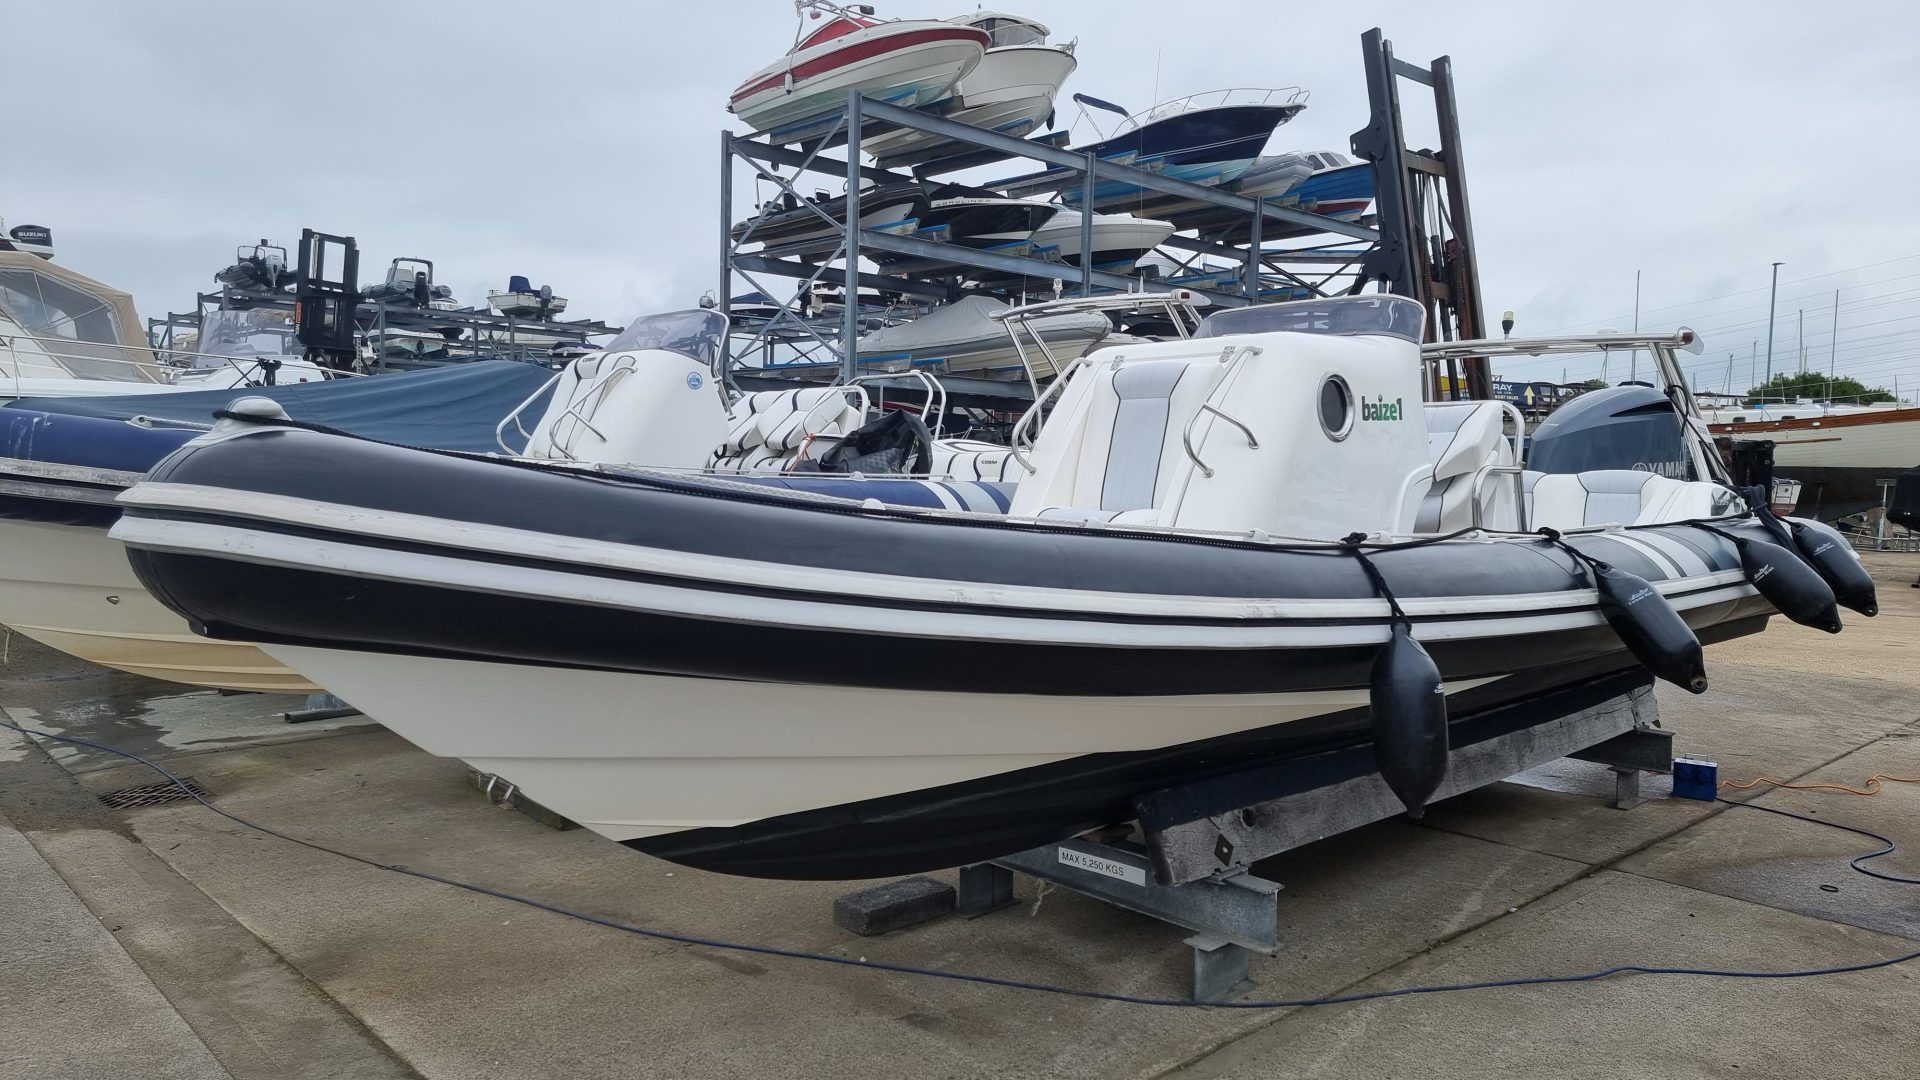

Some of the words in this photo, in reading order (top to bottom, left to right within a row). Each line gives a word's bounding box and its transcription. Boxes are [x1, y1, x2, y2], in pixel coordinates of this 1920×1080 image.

[1361, 393, 1403, 422] baize1
[1062, 851, 1080, 865] MAX
[1105, 863, 1125, 877] KGS
